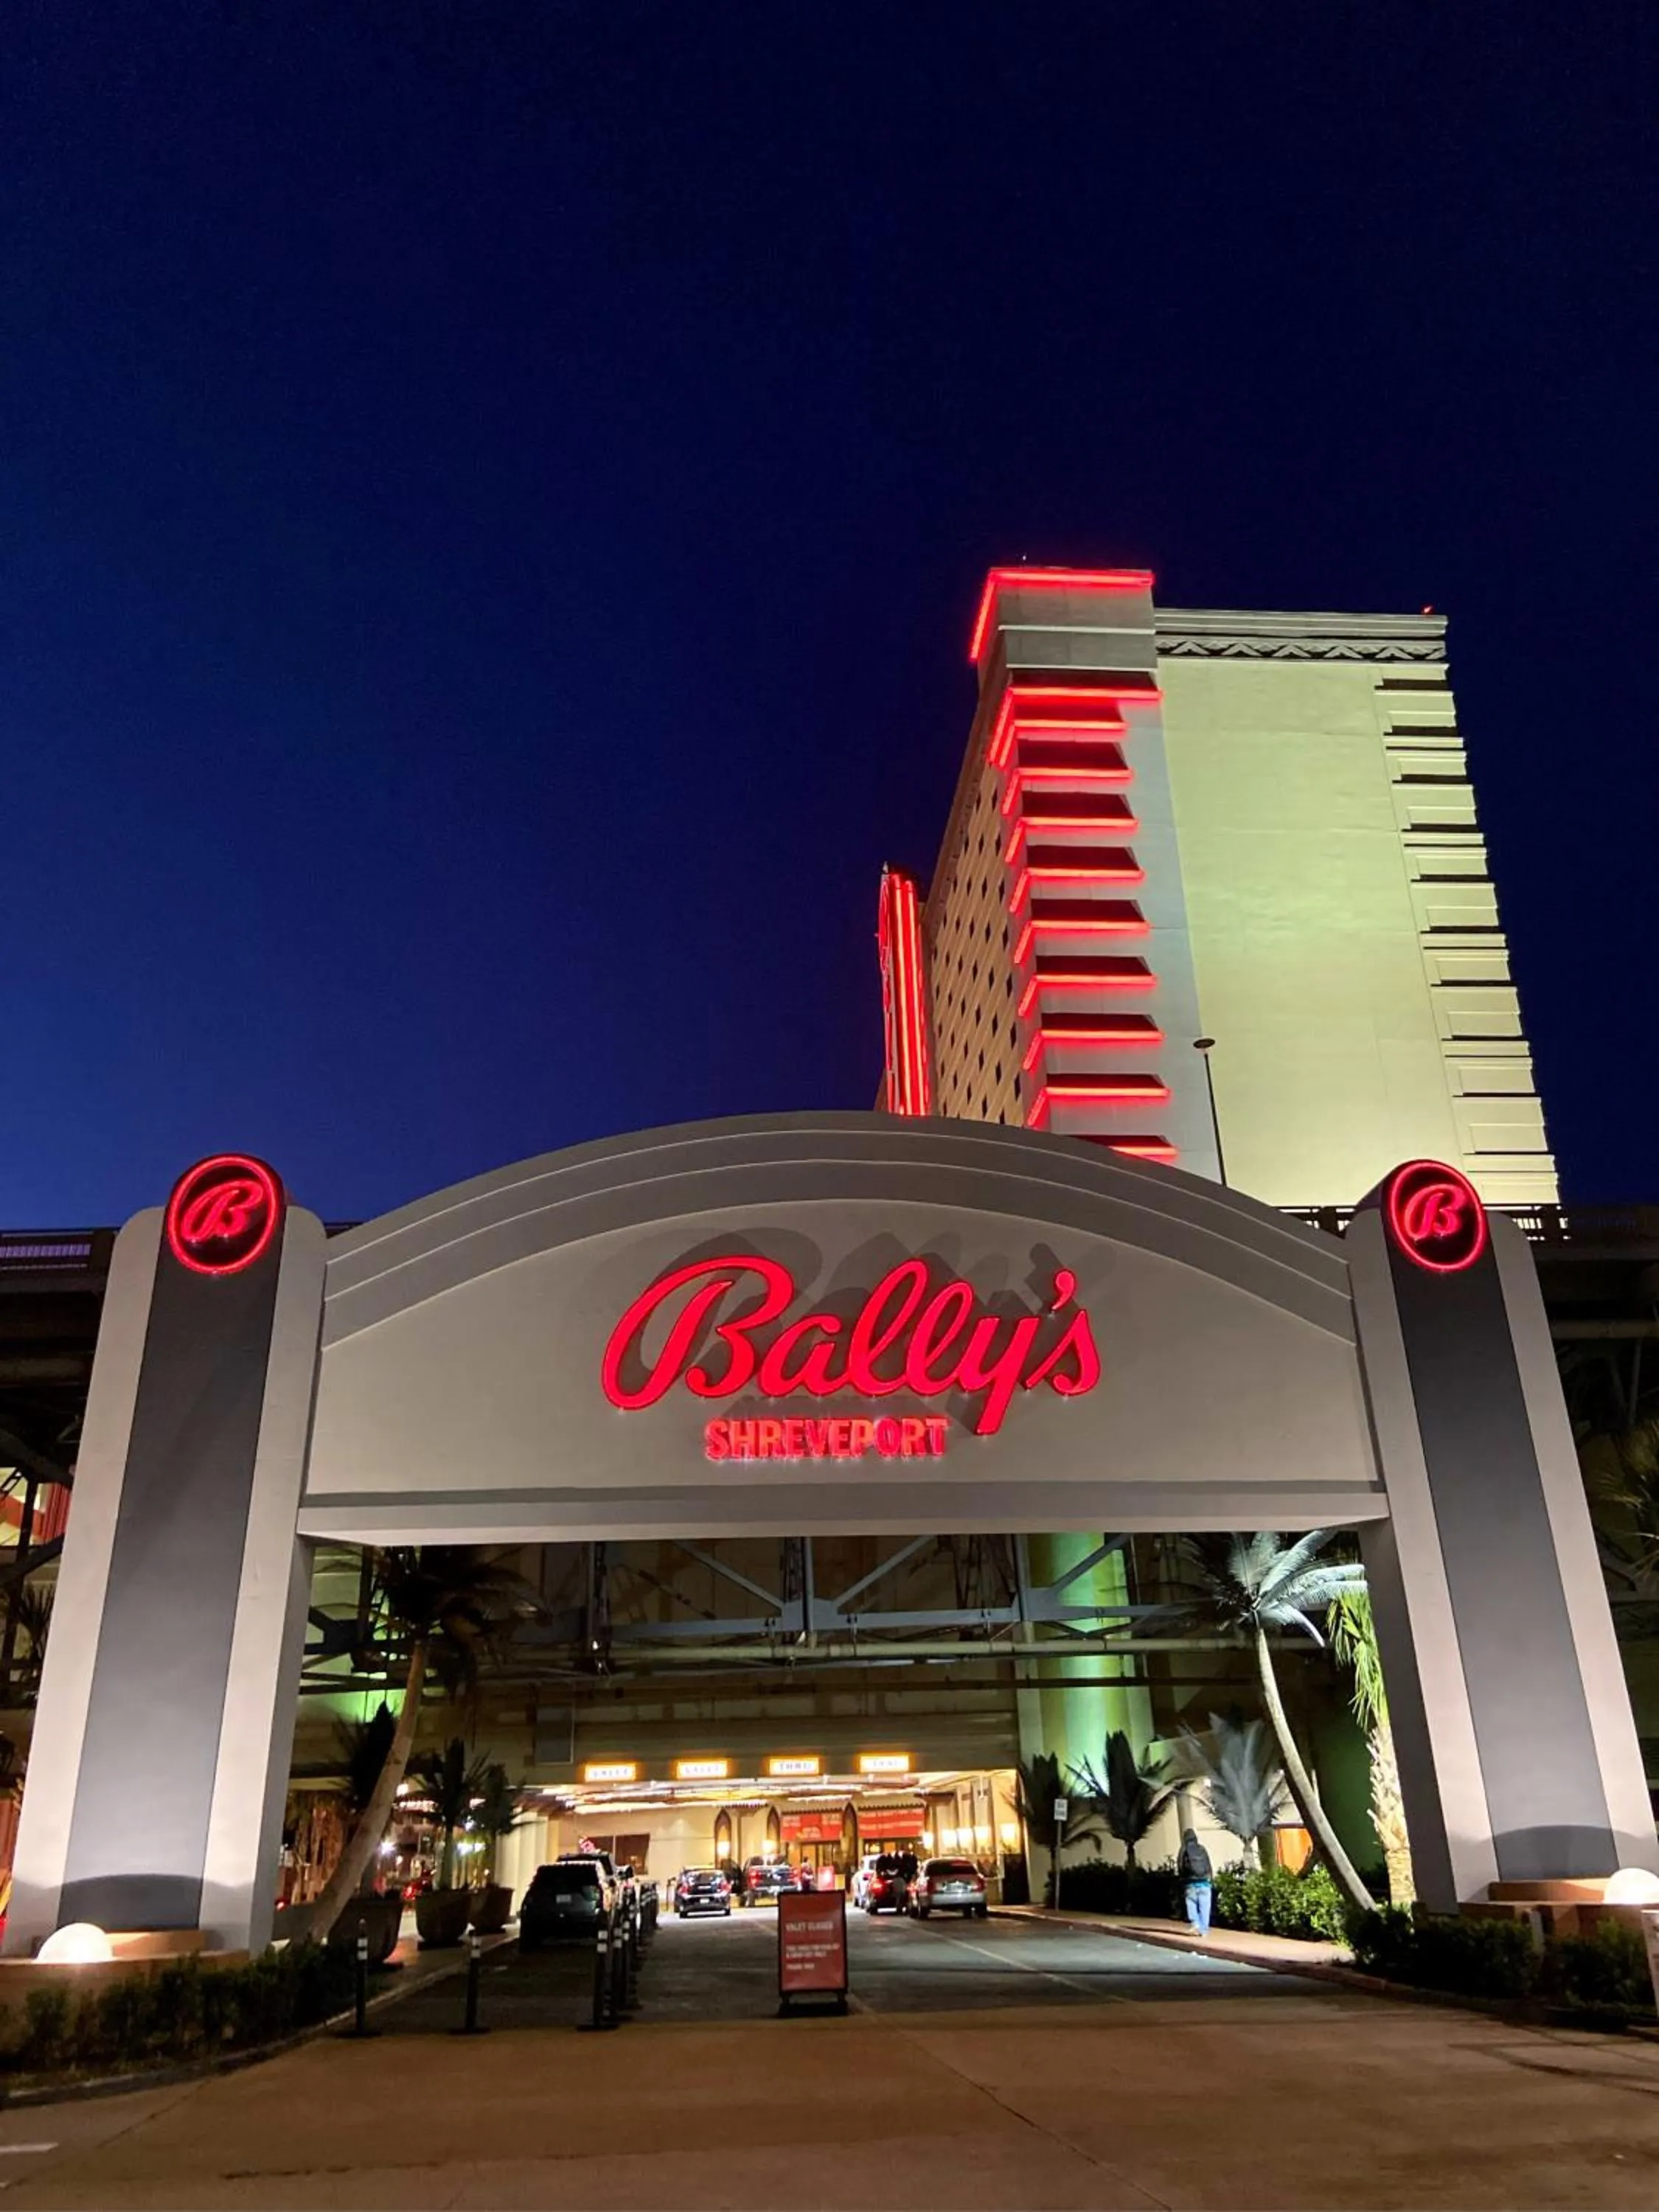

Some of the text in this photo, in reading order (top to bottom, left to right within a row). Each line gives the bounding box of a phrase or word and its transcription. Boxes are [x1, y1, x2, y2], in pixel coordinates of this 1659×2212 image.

[181, 1180, 263, 1242] B
[1404, 1183, 1465, 1239] B
[601, 1256, 1099, 1435] Bally's
[705, 1416, 949, 1460] SHREVEPORT
